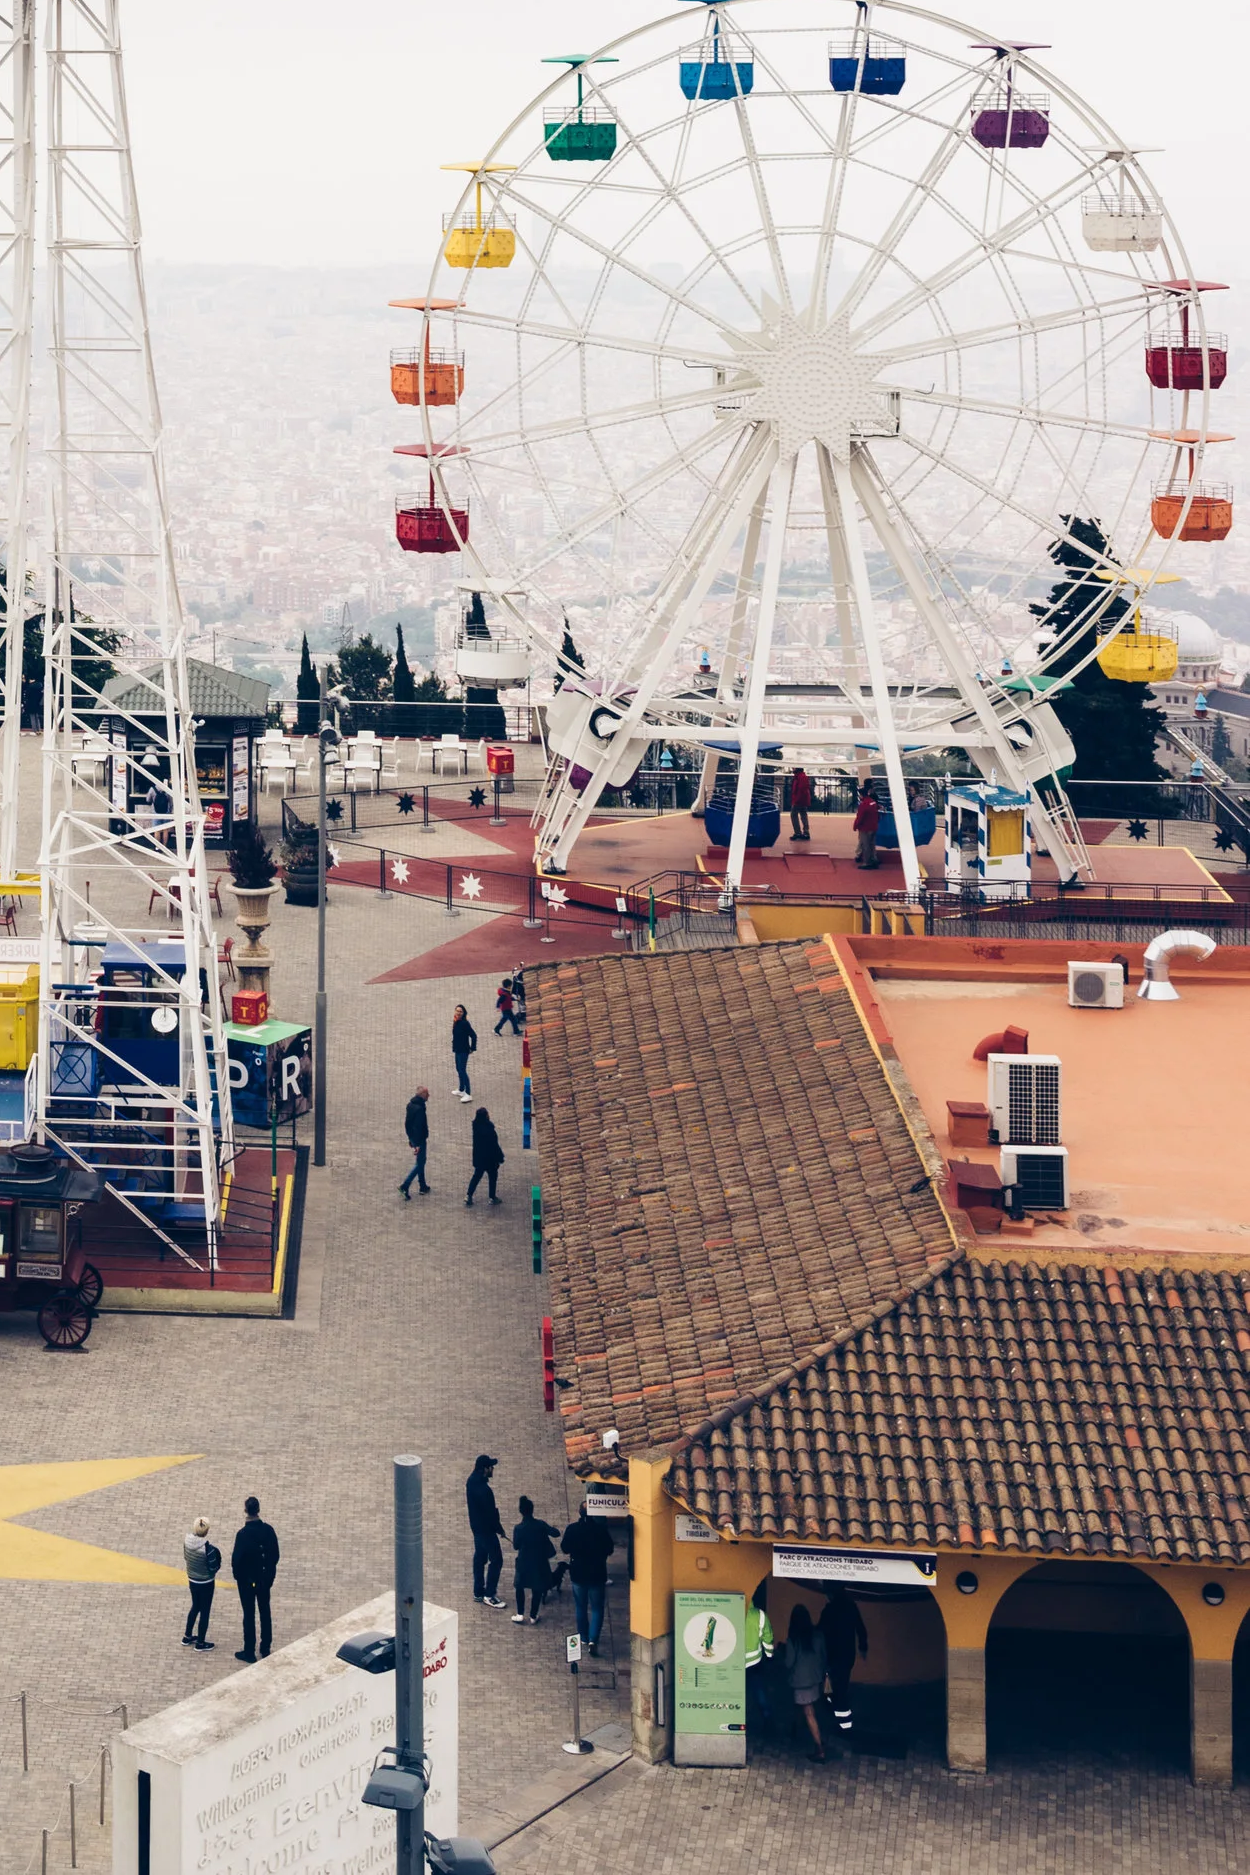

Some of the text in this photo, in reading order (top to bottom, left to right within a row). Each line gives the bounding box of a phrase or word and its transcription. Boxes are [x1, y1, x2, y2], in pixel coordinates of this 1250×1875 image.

[282, 1055, 301, 1101] R
[796, 1555, 843, 1563] D'ATRACCIONS
[423, 1656, 447, 1679] IDABO
